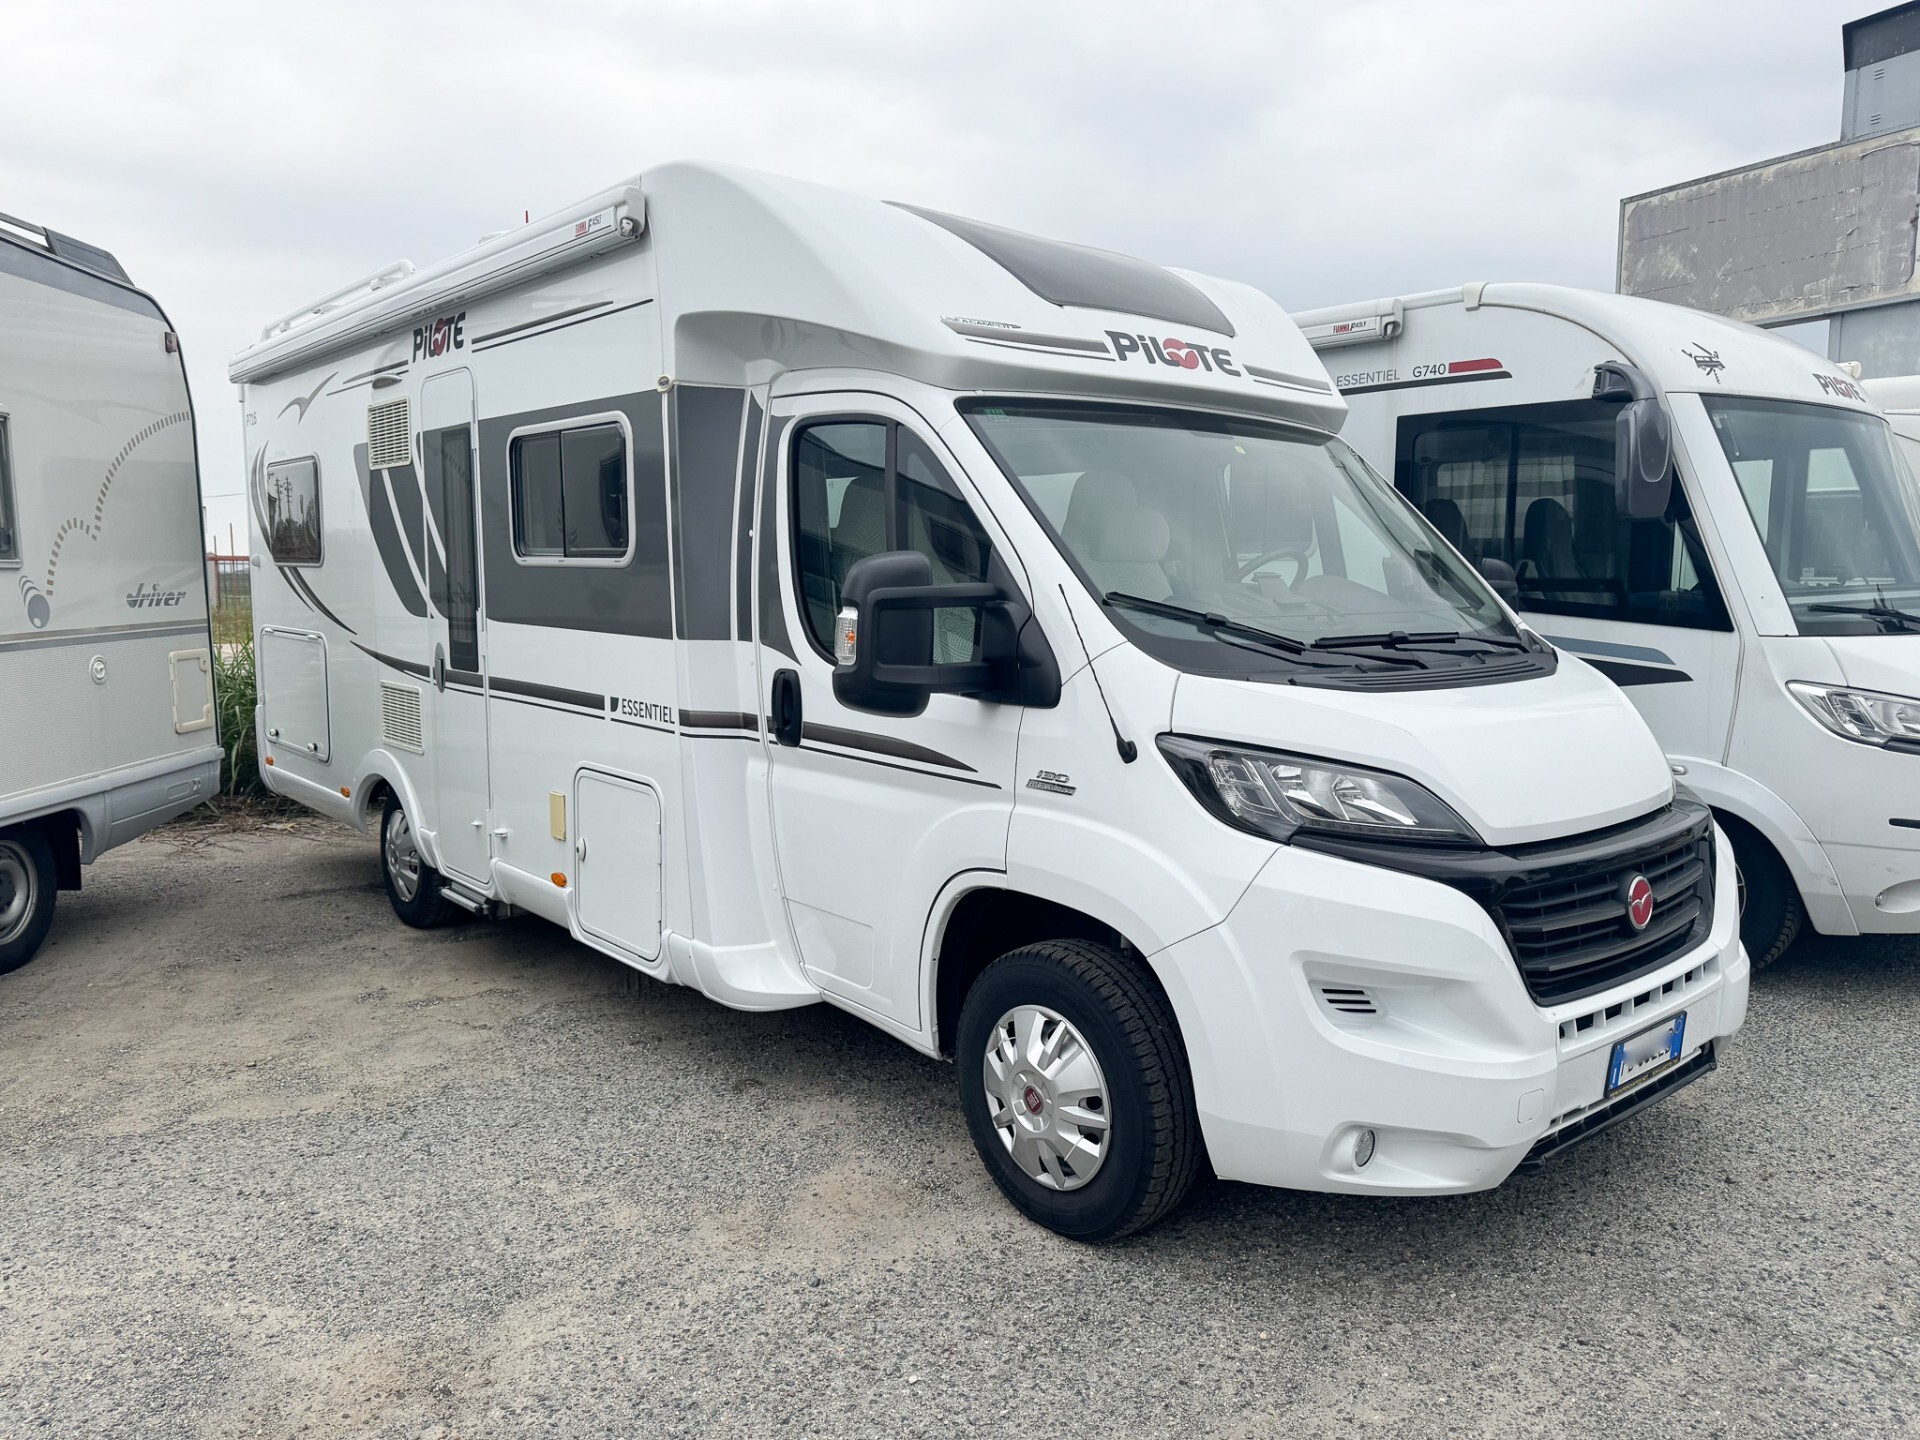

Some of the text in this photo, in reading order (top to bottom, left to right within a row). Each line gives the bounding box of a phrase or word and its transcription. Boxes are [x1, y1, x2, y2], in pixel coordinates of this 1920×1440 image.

[1336, 363, 1446, 387] ESSENTIEL G740
[621, 698, 676, 724] ESSENTIEL
